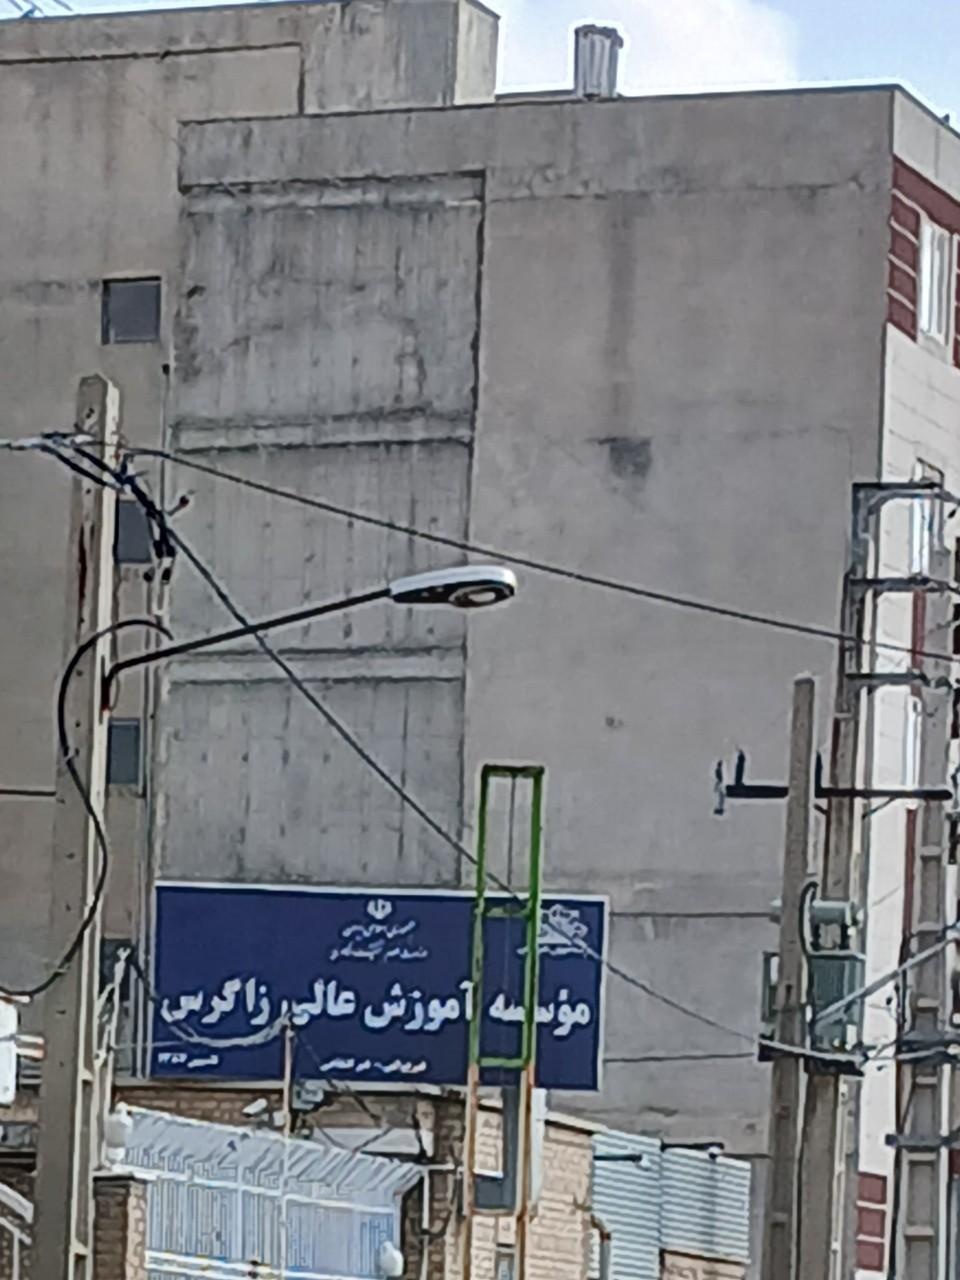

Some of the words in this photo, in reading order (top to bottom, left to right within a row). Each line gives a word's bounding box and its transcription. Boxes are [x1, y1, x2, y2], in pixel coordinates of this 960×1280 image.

[160, 977, 280, 1026] زاگرس
[281, 977, 357, 1027] عالی
[363, 980, 475, 1031] آموزش
